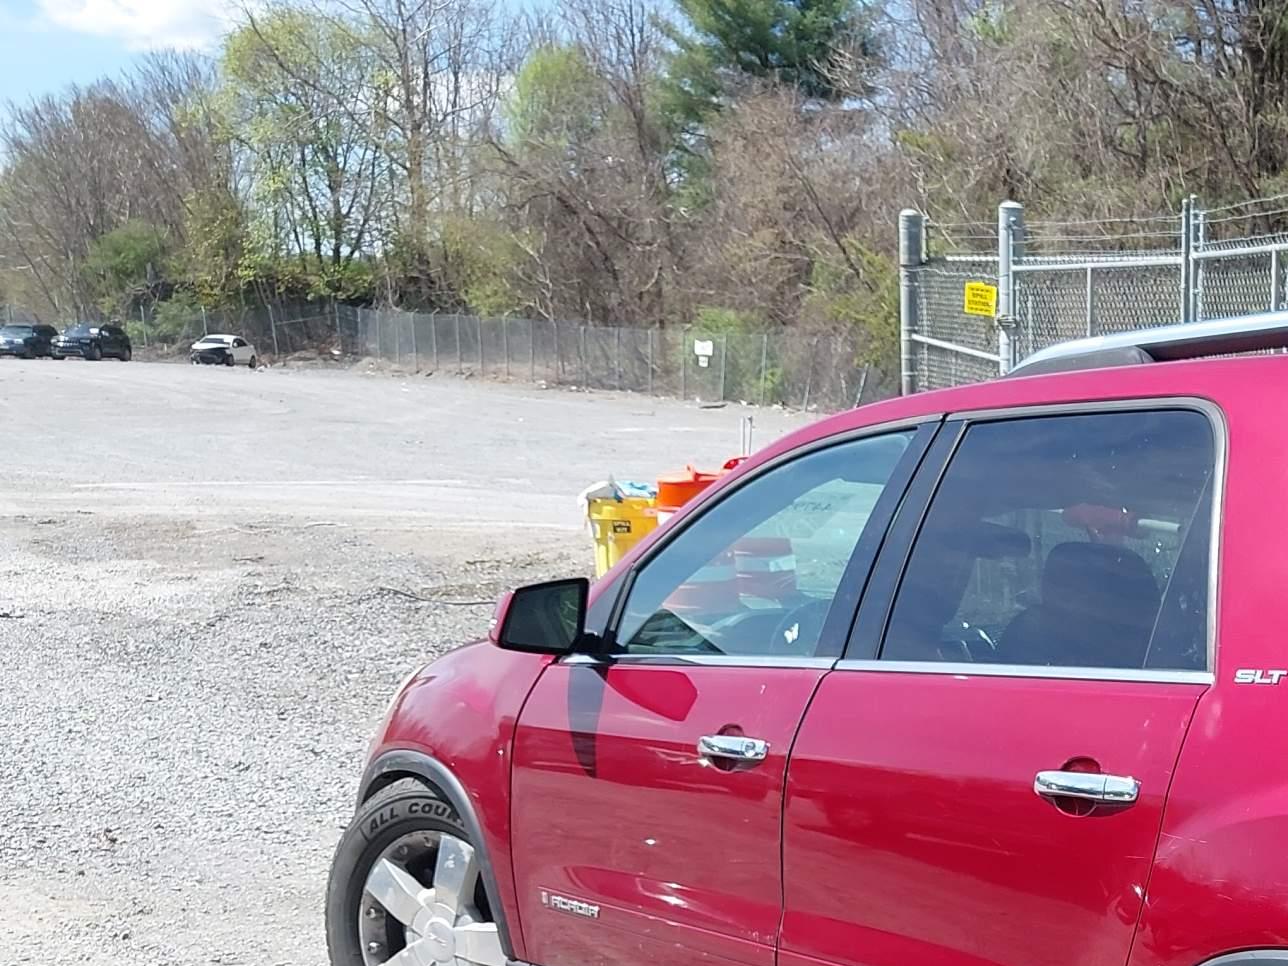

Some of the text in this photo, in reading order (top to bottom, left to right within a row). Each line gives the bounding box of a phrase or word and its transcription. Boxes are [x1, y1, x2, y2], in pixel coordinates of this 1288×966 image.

[1233, 668, 1288, 685] SLT
[369, 807, 400, 834] ALL
[551, 895, 600, 918] ACADIA
